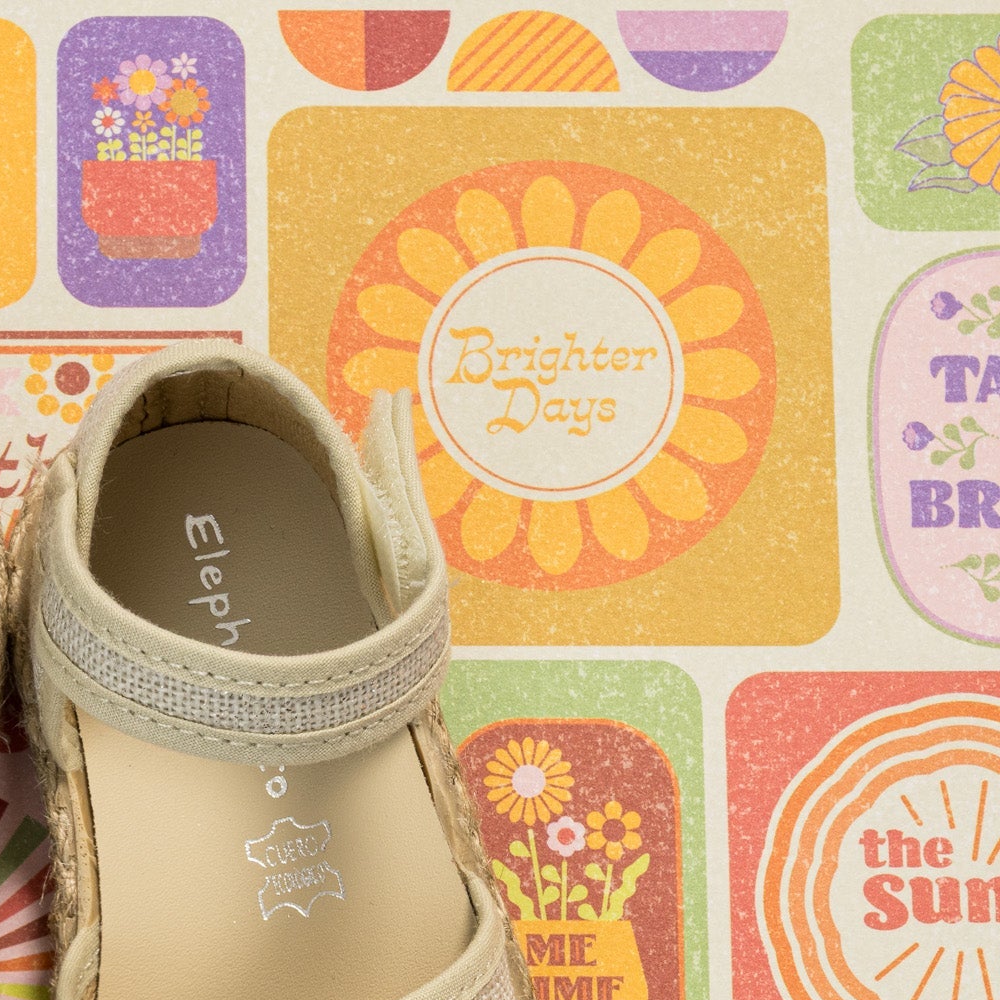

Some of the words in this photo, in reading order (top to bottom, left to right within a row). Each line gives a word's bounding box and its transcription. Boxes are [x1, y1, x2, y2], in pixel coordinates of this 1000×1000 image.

[446, 326, 658, 385] Brighter
[487, 379, 617, 437] Days
[265, 834, 318, 867] CUERO
[858, 828, 954, 868] the
[526, 933, 597, 966] ME
